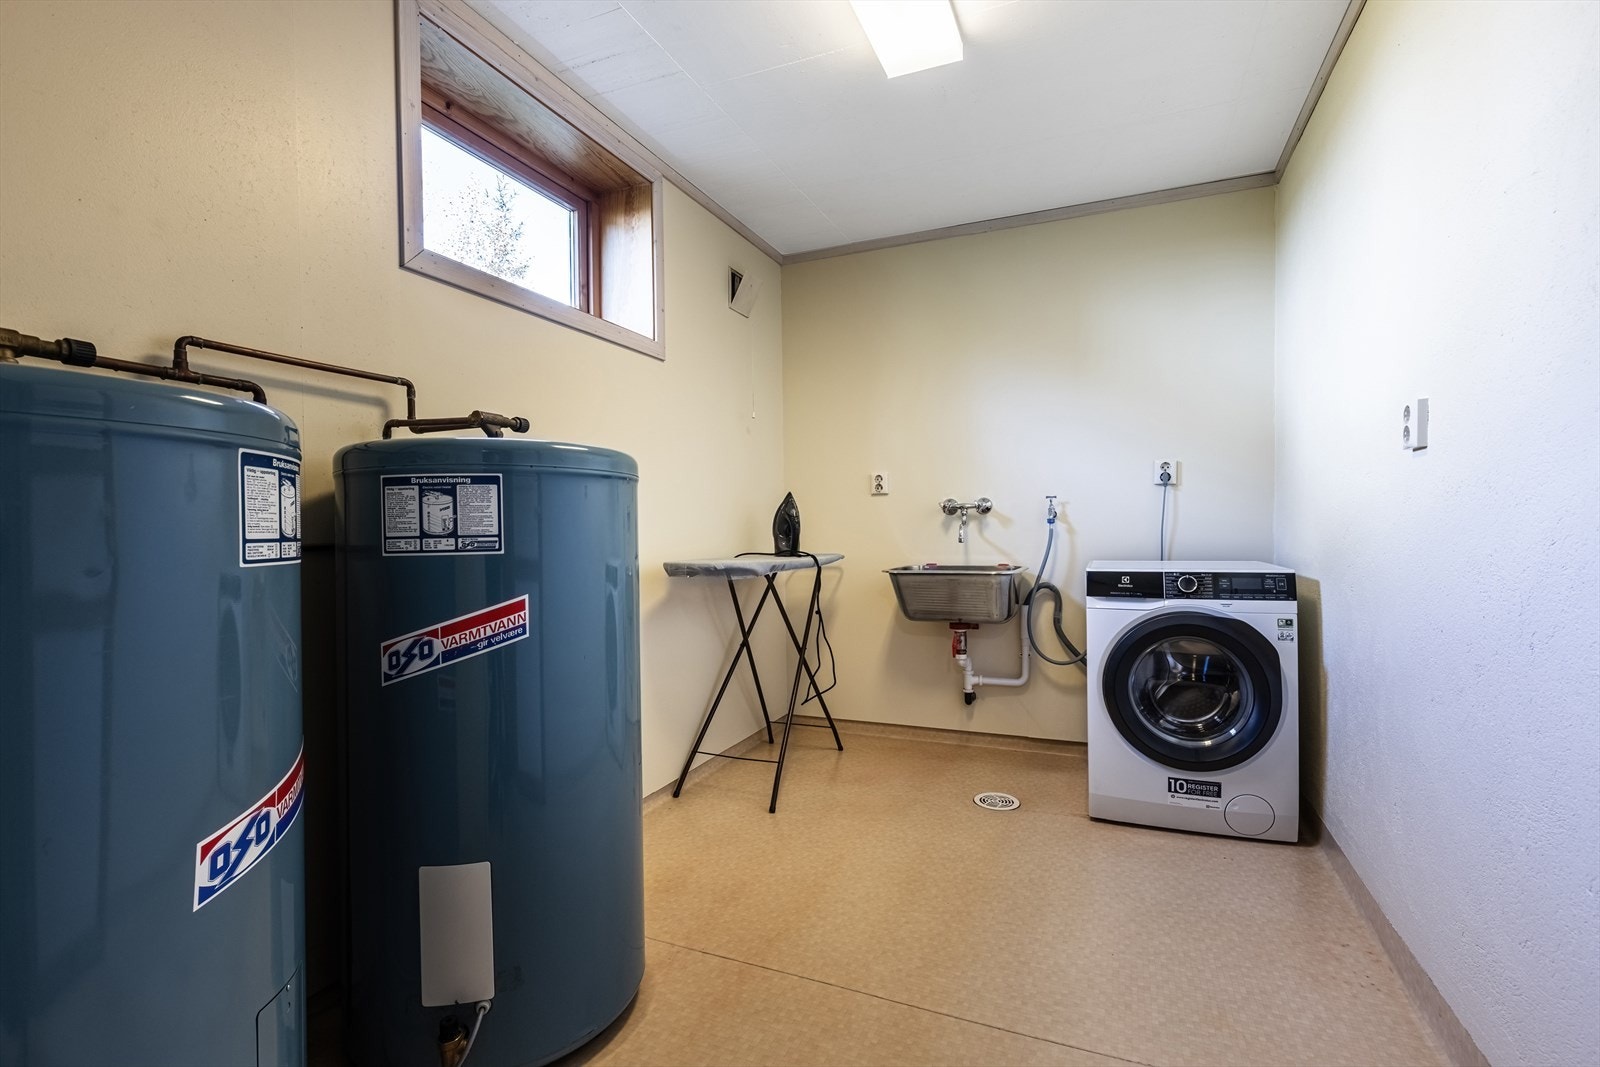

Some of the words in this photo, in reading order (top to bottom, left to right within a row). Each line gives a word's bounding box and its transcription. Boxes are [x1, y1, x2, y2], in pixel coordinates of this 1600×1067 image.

[440, 611, 527, 650] VARMTVANN
[491, 627, 523, 644] velvære
[388, 636, 434, 677] OSO
[1169, 779, 1186, 793] 10
[1188, 783, 1218, 792] REGISTER
[208, 807, 272, 890] OSO
